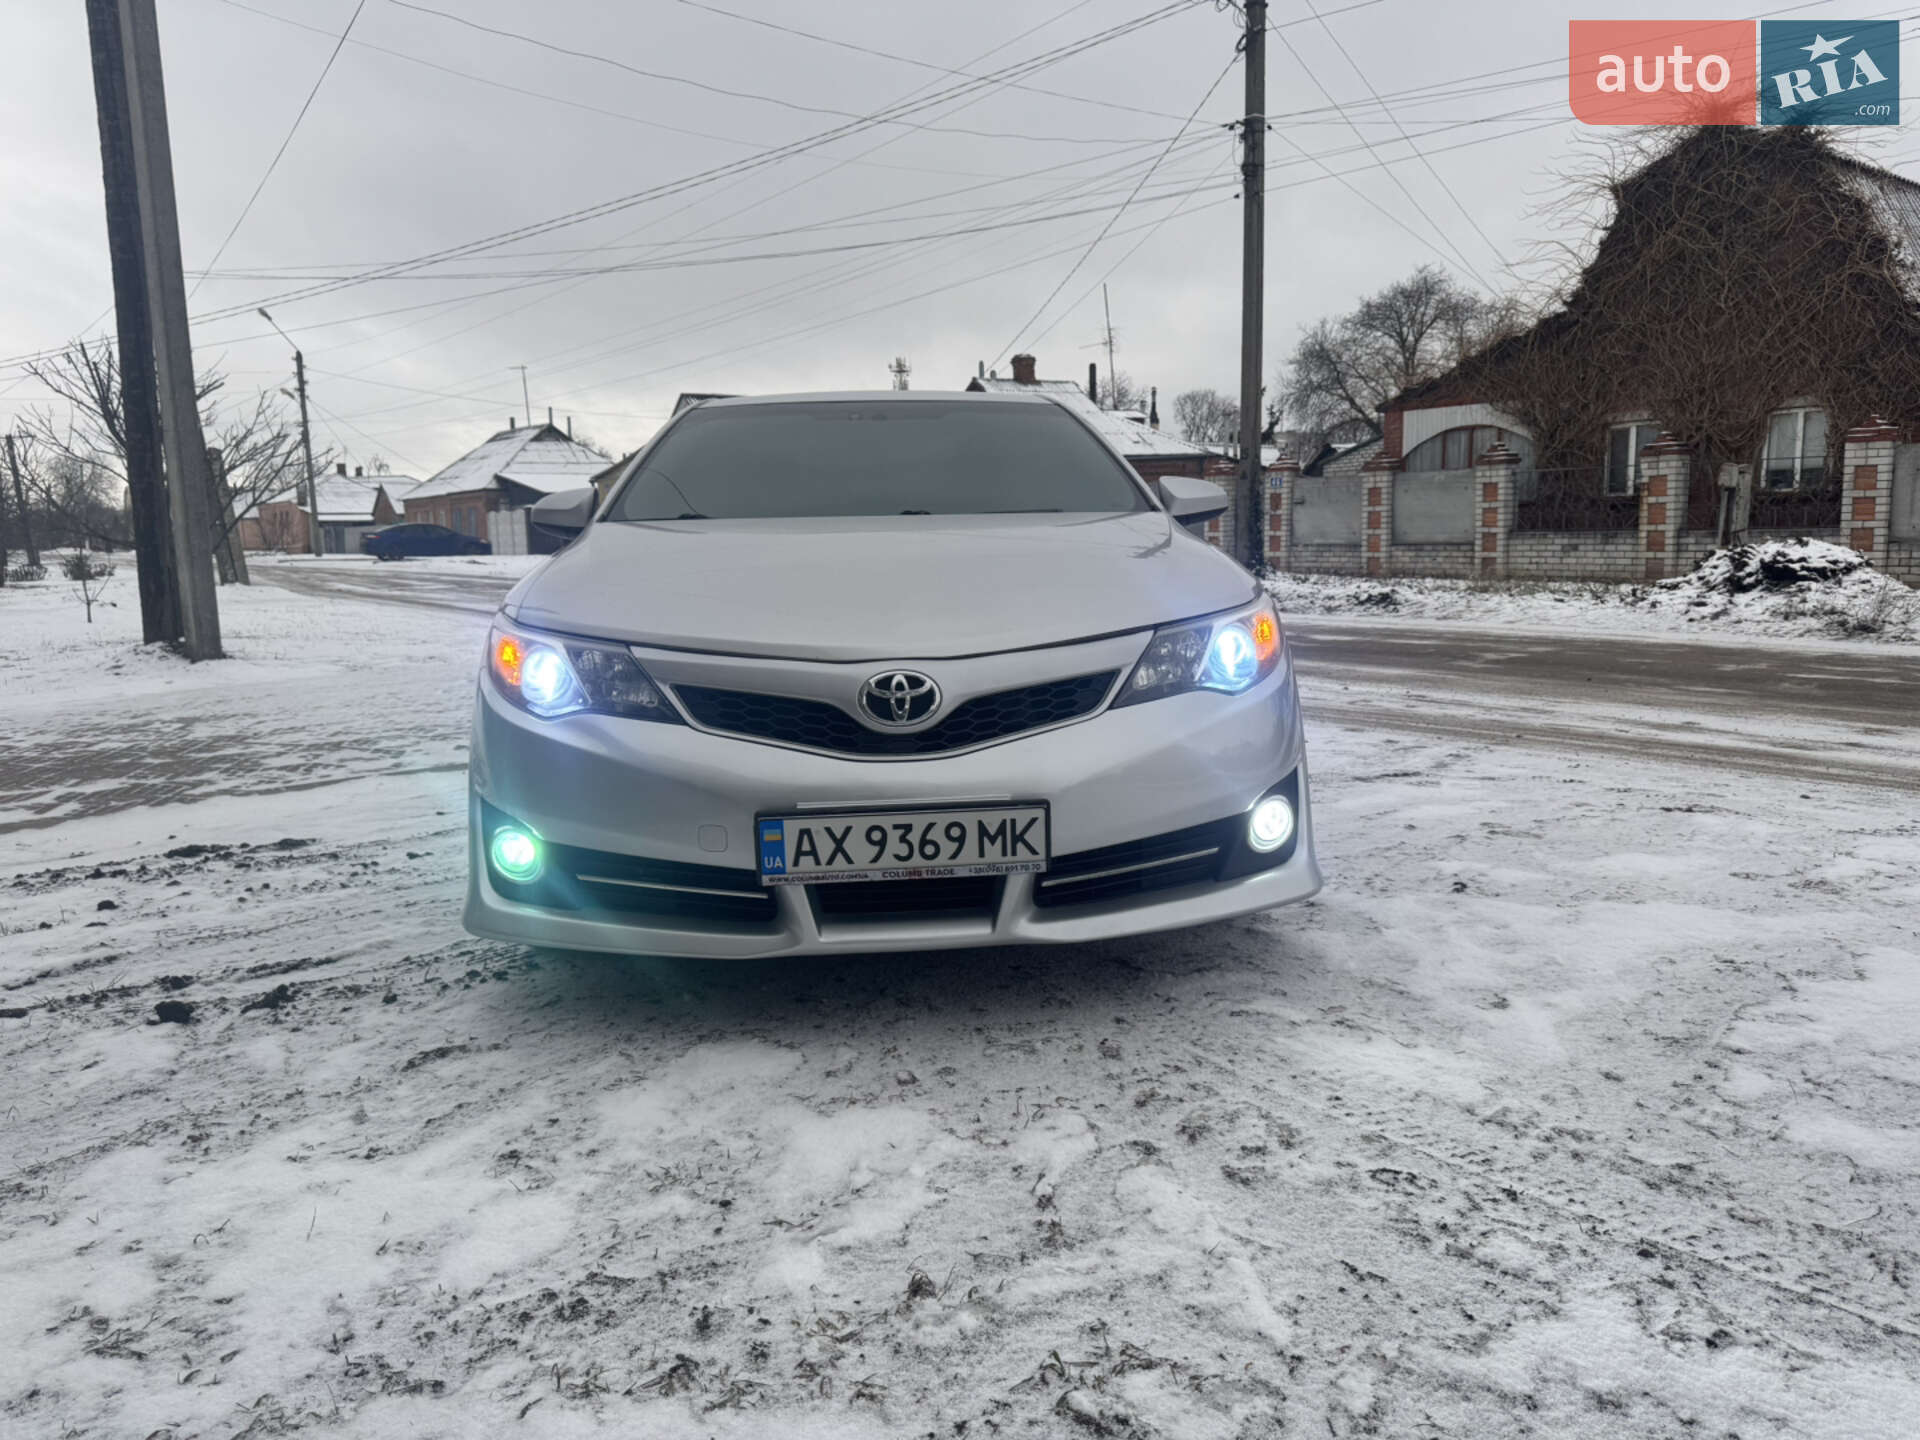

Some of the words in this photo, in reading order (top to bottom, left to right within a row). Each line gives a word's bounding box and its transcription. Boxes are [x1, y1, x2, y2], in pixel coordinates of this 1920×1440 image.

[792, 825, 855, 868] AX
[865, 821, 968, 864] 9369
[977, 816, 1040, 859] MK
[764, 855, 784, 869] UA
[925, 867, 955, 877] TRADE
